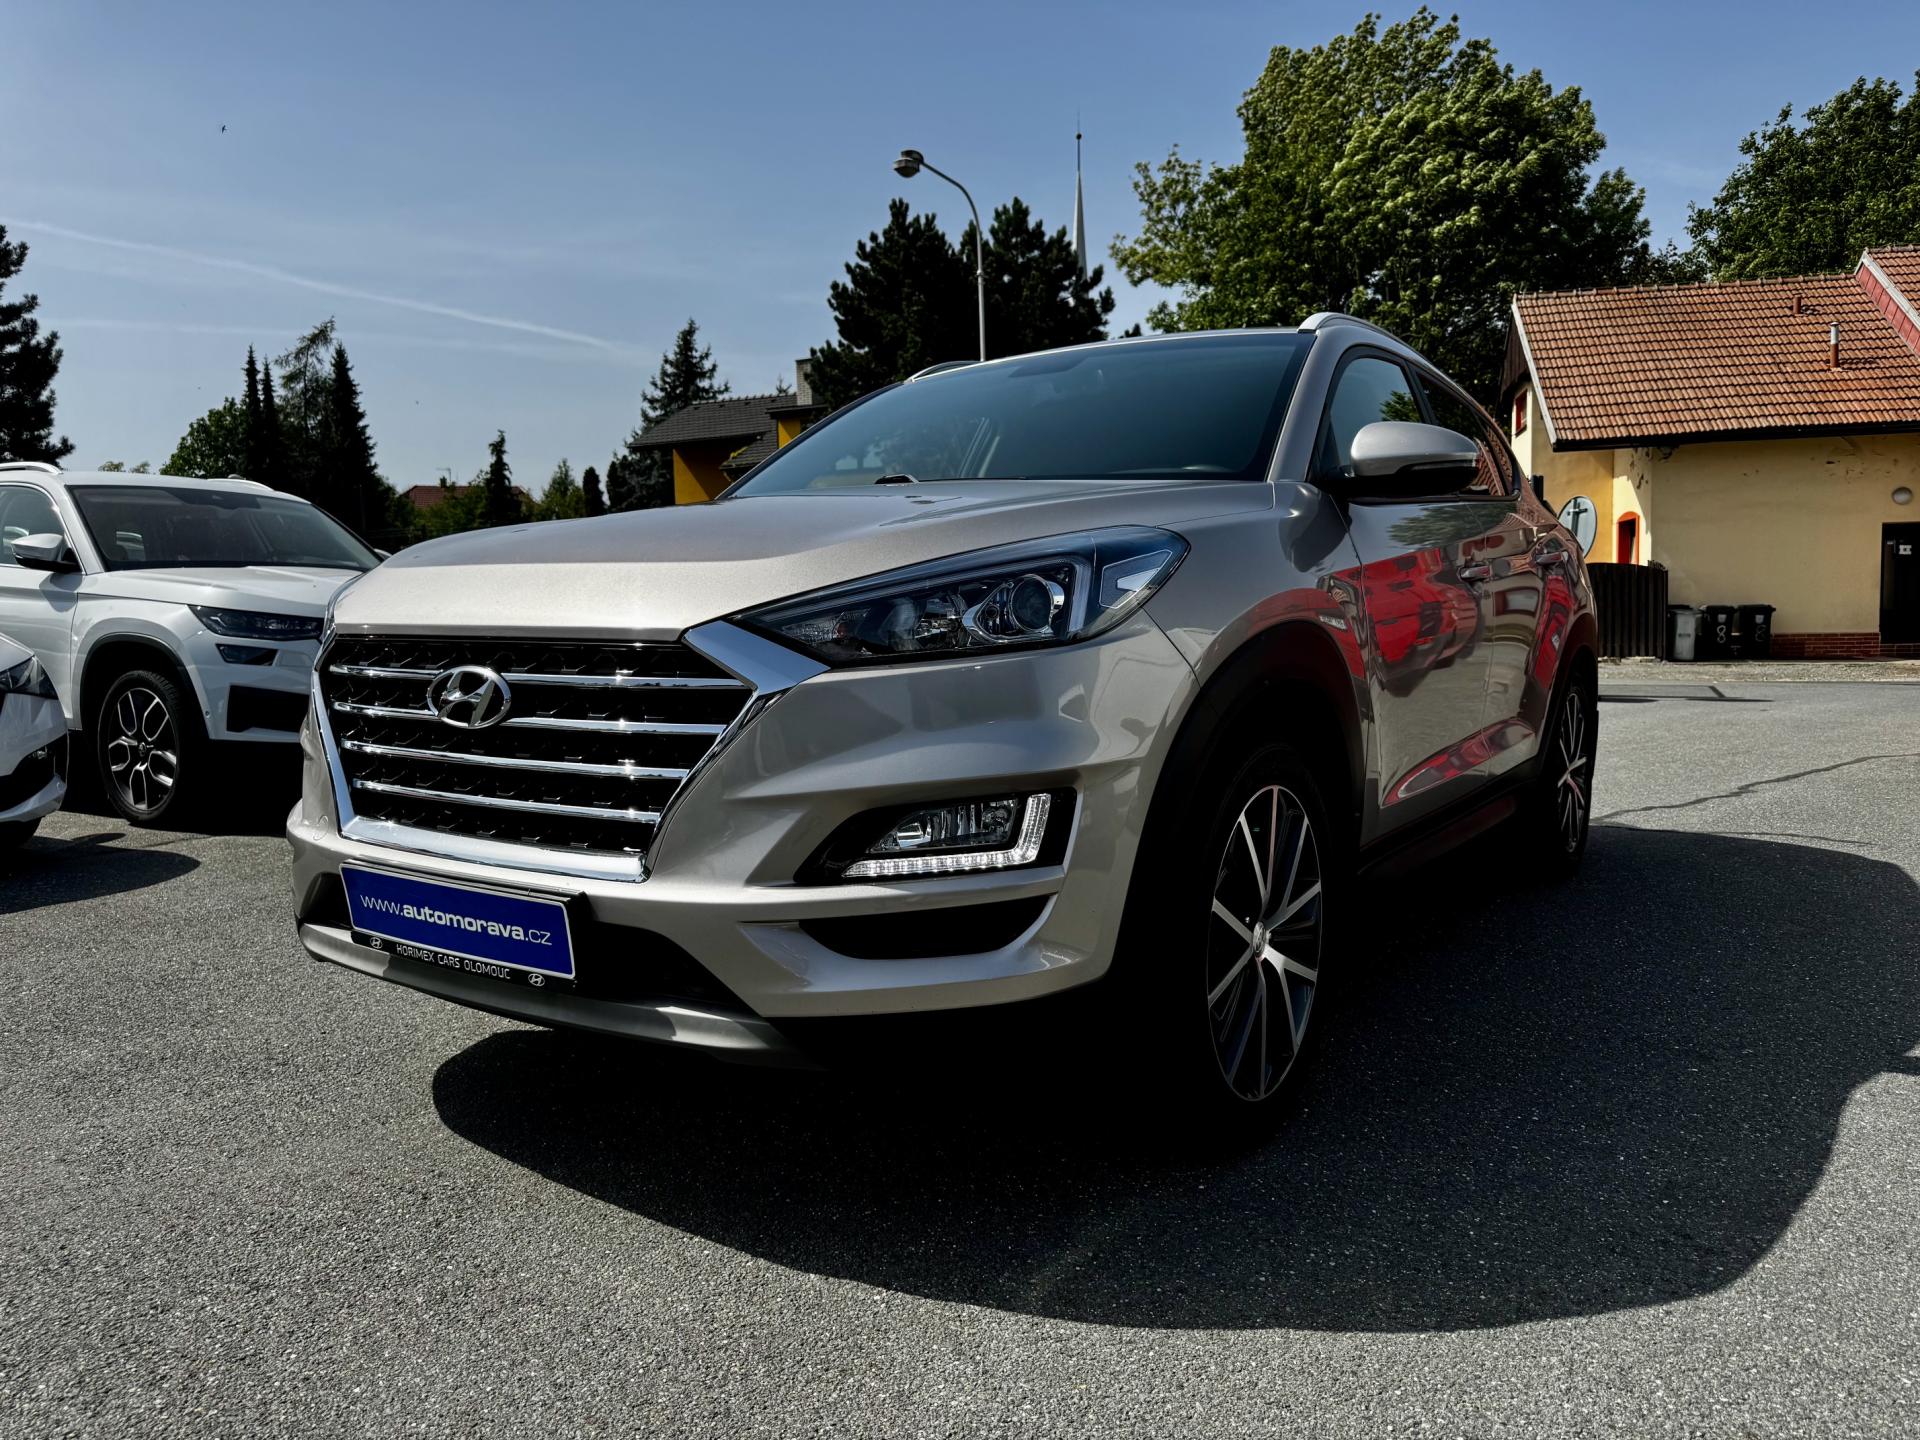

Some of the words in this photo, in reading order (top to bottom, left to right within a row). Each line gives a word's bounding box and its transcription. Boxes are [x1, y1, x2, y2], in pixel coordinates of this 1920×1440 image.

[360, 894, 553, 946] www.automorava.cz
[396, 943, 435, 962] HORIMEX
[437, 954, 461, 969] CARS
[463, 959, 511, 980] OLOMOUC
